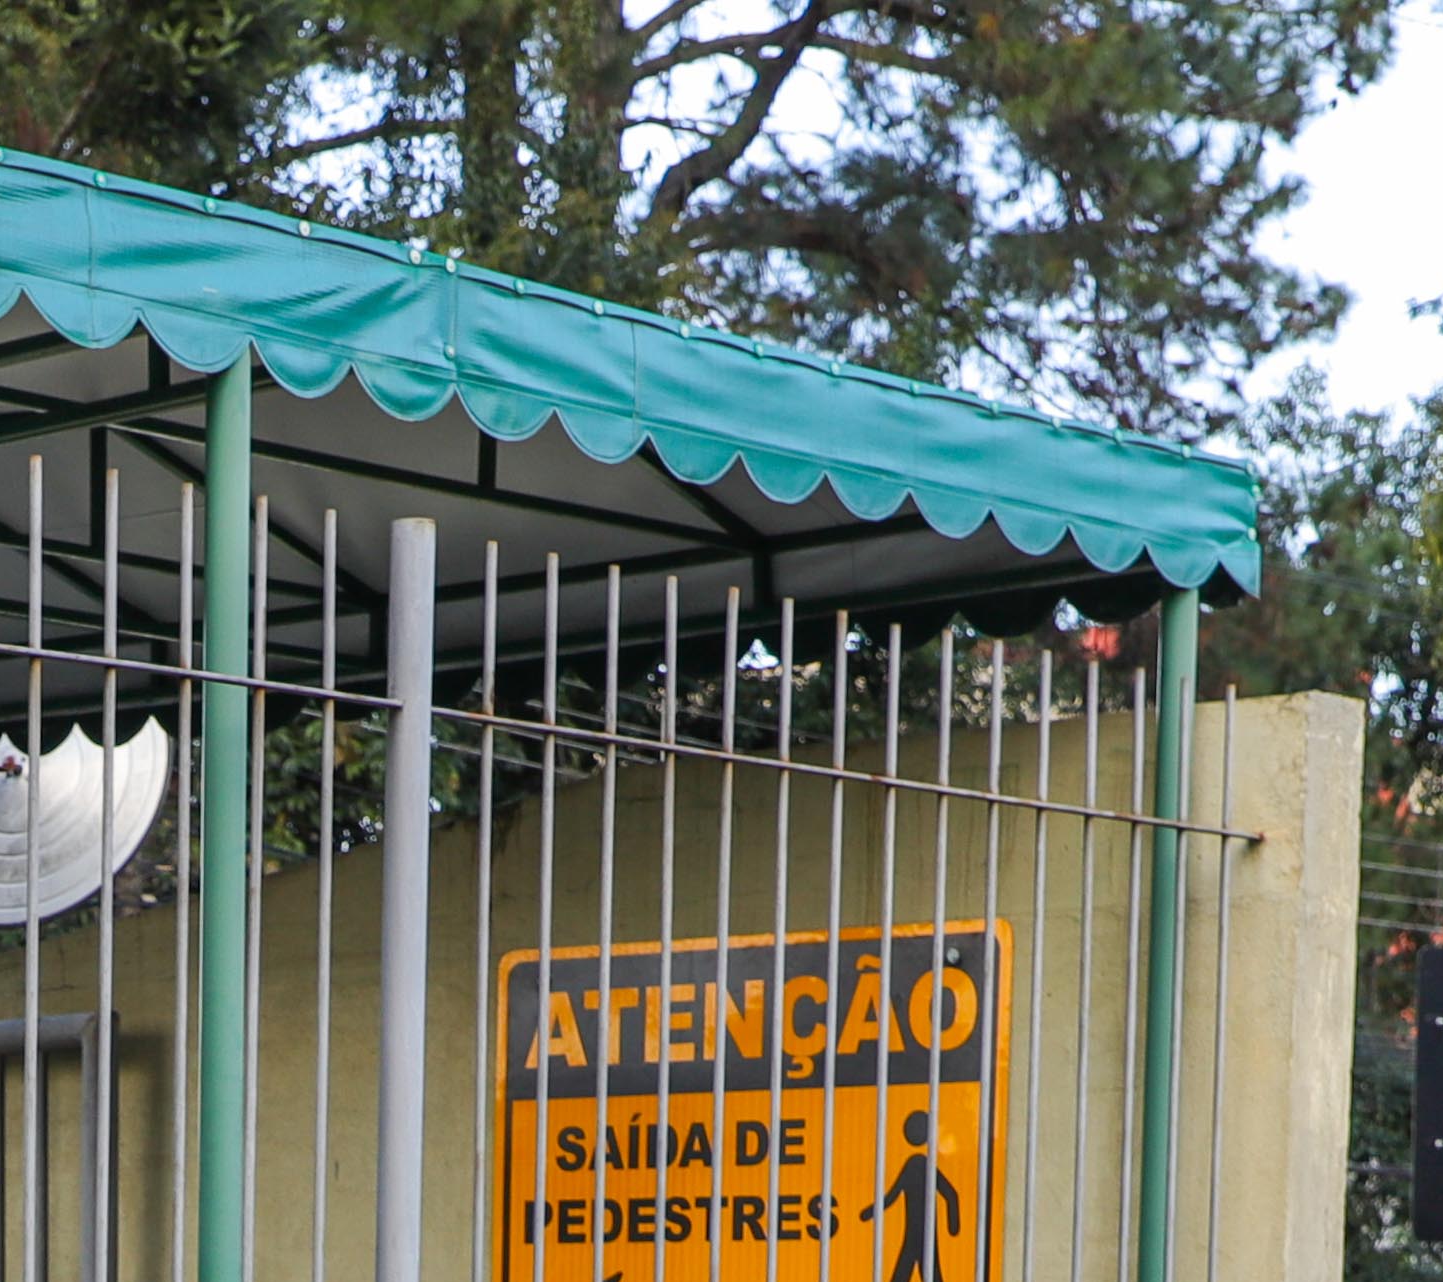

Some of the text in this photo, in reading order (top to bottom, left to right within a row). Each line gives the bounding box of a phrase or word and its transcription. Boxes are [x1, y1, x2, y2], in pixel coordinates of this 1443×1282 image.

[524, 954, 980, 1080] ATENÇÃO
[556, 1113, 806, 1171] SAÍDA DE
[524, 1195, 840, 1245] PEDESTRES
